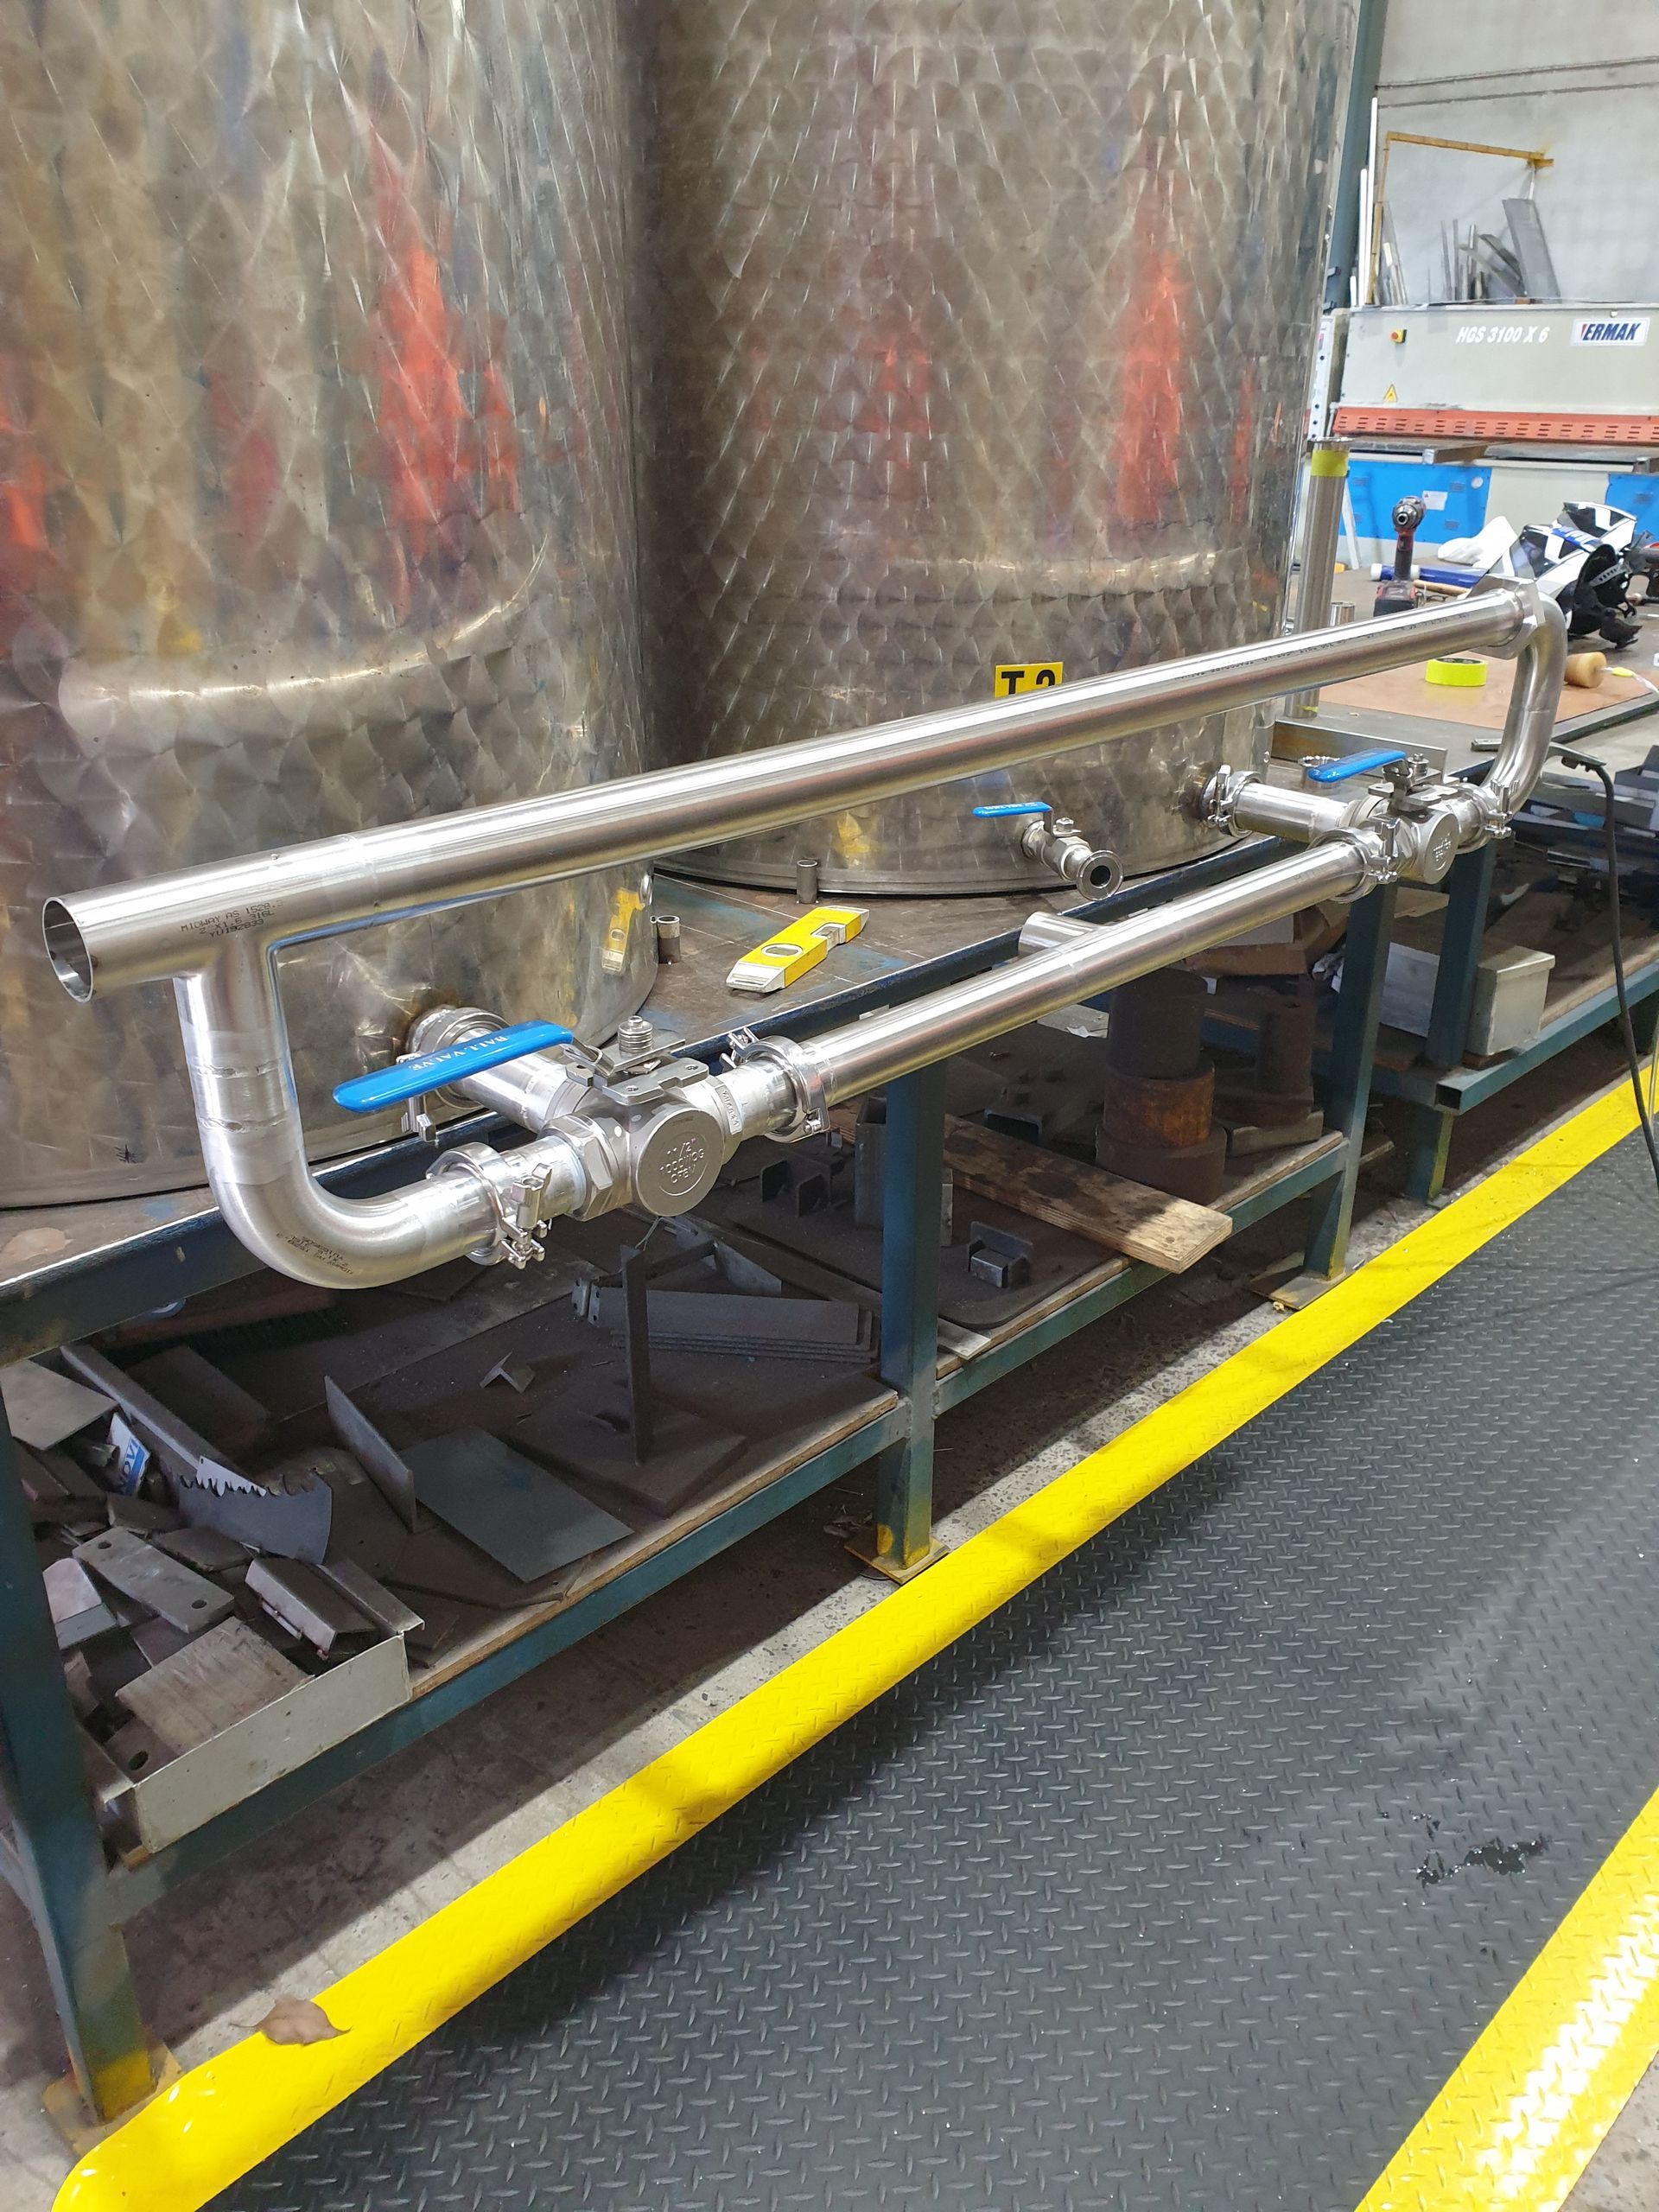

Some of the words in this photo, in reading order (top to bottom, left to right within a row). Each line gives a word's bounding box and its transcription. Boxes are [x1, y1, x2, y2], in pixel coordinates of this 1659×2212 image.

[1455, 327, 1485, 343] HGS
[1487, 327, 1522, 343] 3100
[1523, 327, 1537, 343] X
[1538, 327, 1551, 343] 6
